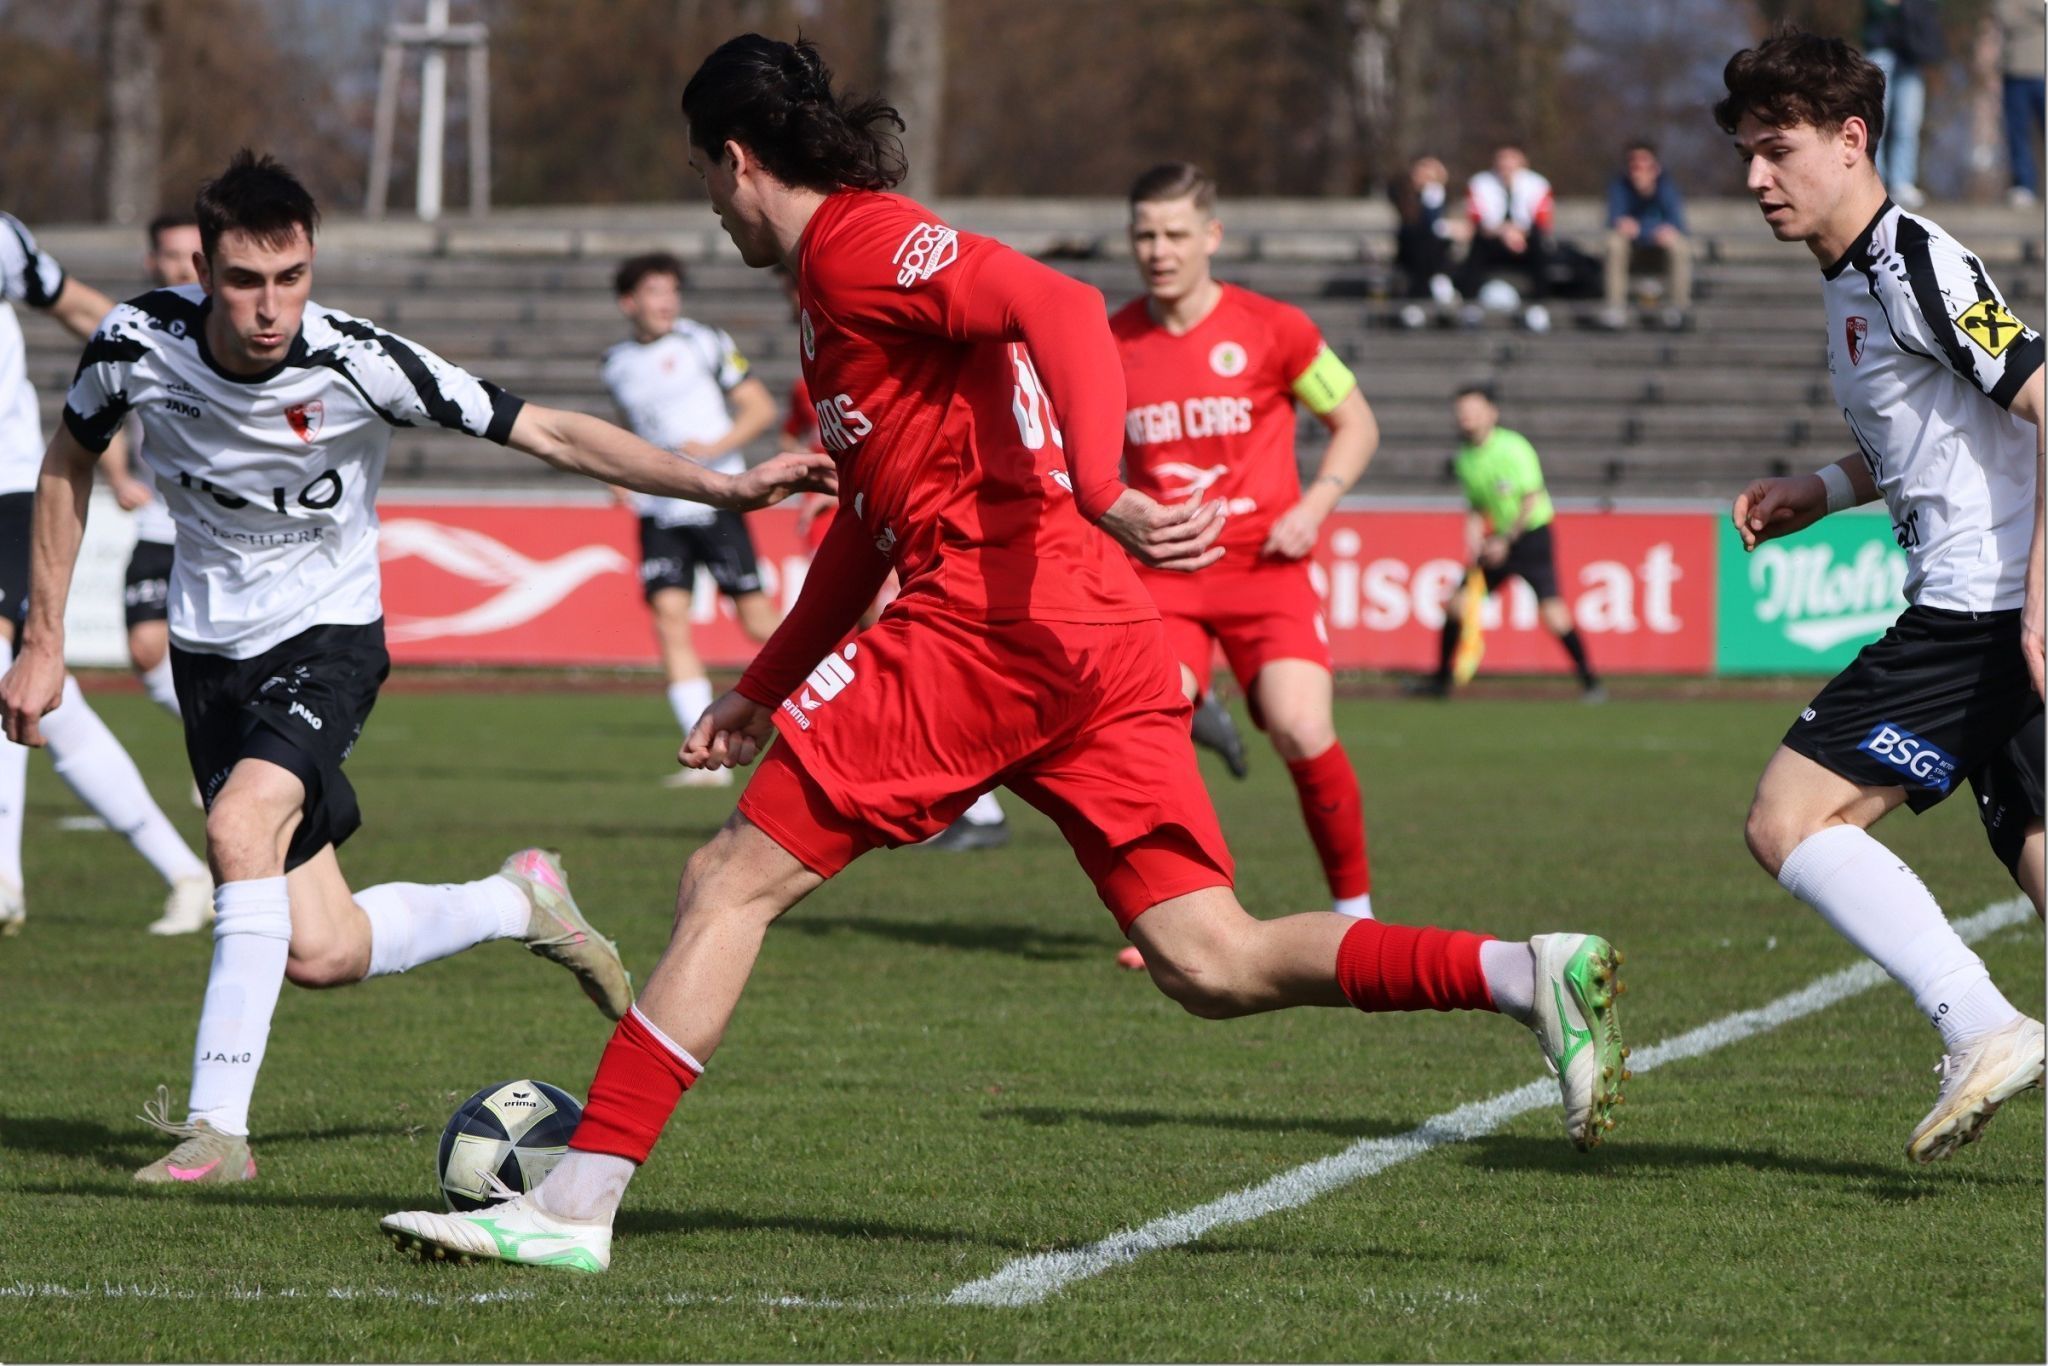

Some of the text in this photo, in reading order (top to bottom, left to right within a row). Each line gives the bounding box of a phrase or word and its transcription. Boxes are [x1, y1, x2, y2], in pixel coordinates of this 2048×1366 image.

[165, 399, 200, 418] JAKO
[1184, 396, 1253, 438] CARS
[288, 701, 322, 730] JAKO
[782, 698, 811, 731] erima
[1868, 726, 1940, 778] BSG
[201, 1051, 251, 1064] JAKO
[504, 1100, 537, 1108] erima
